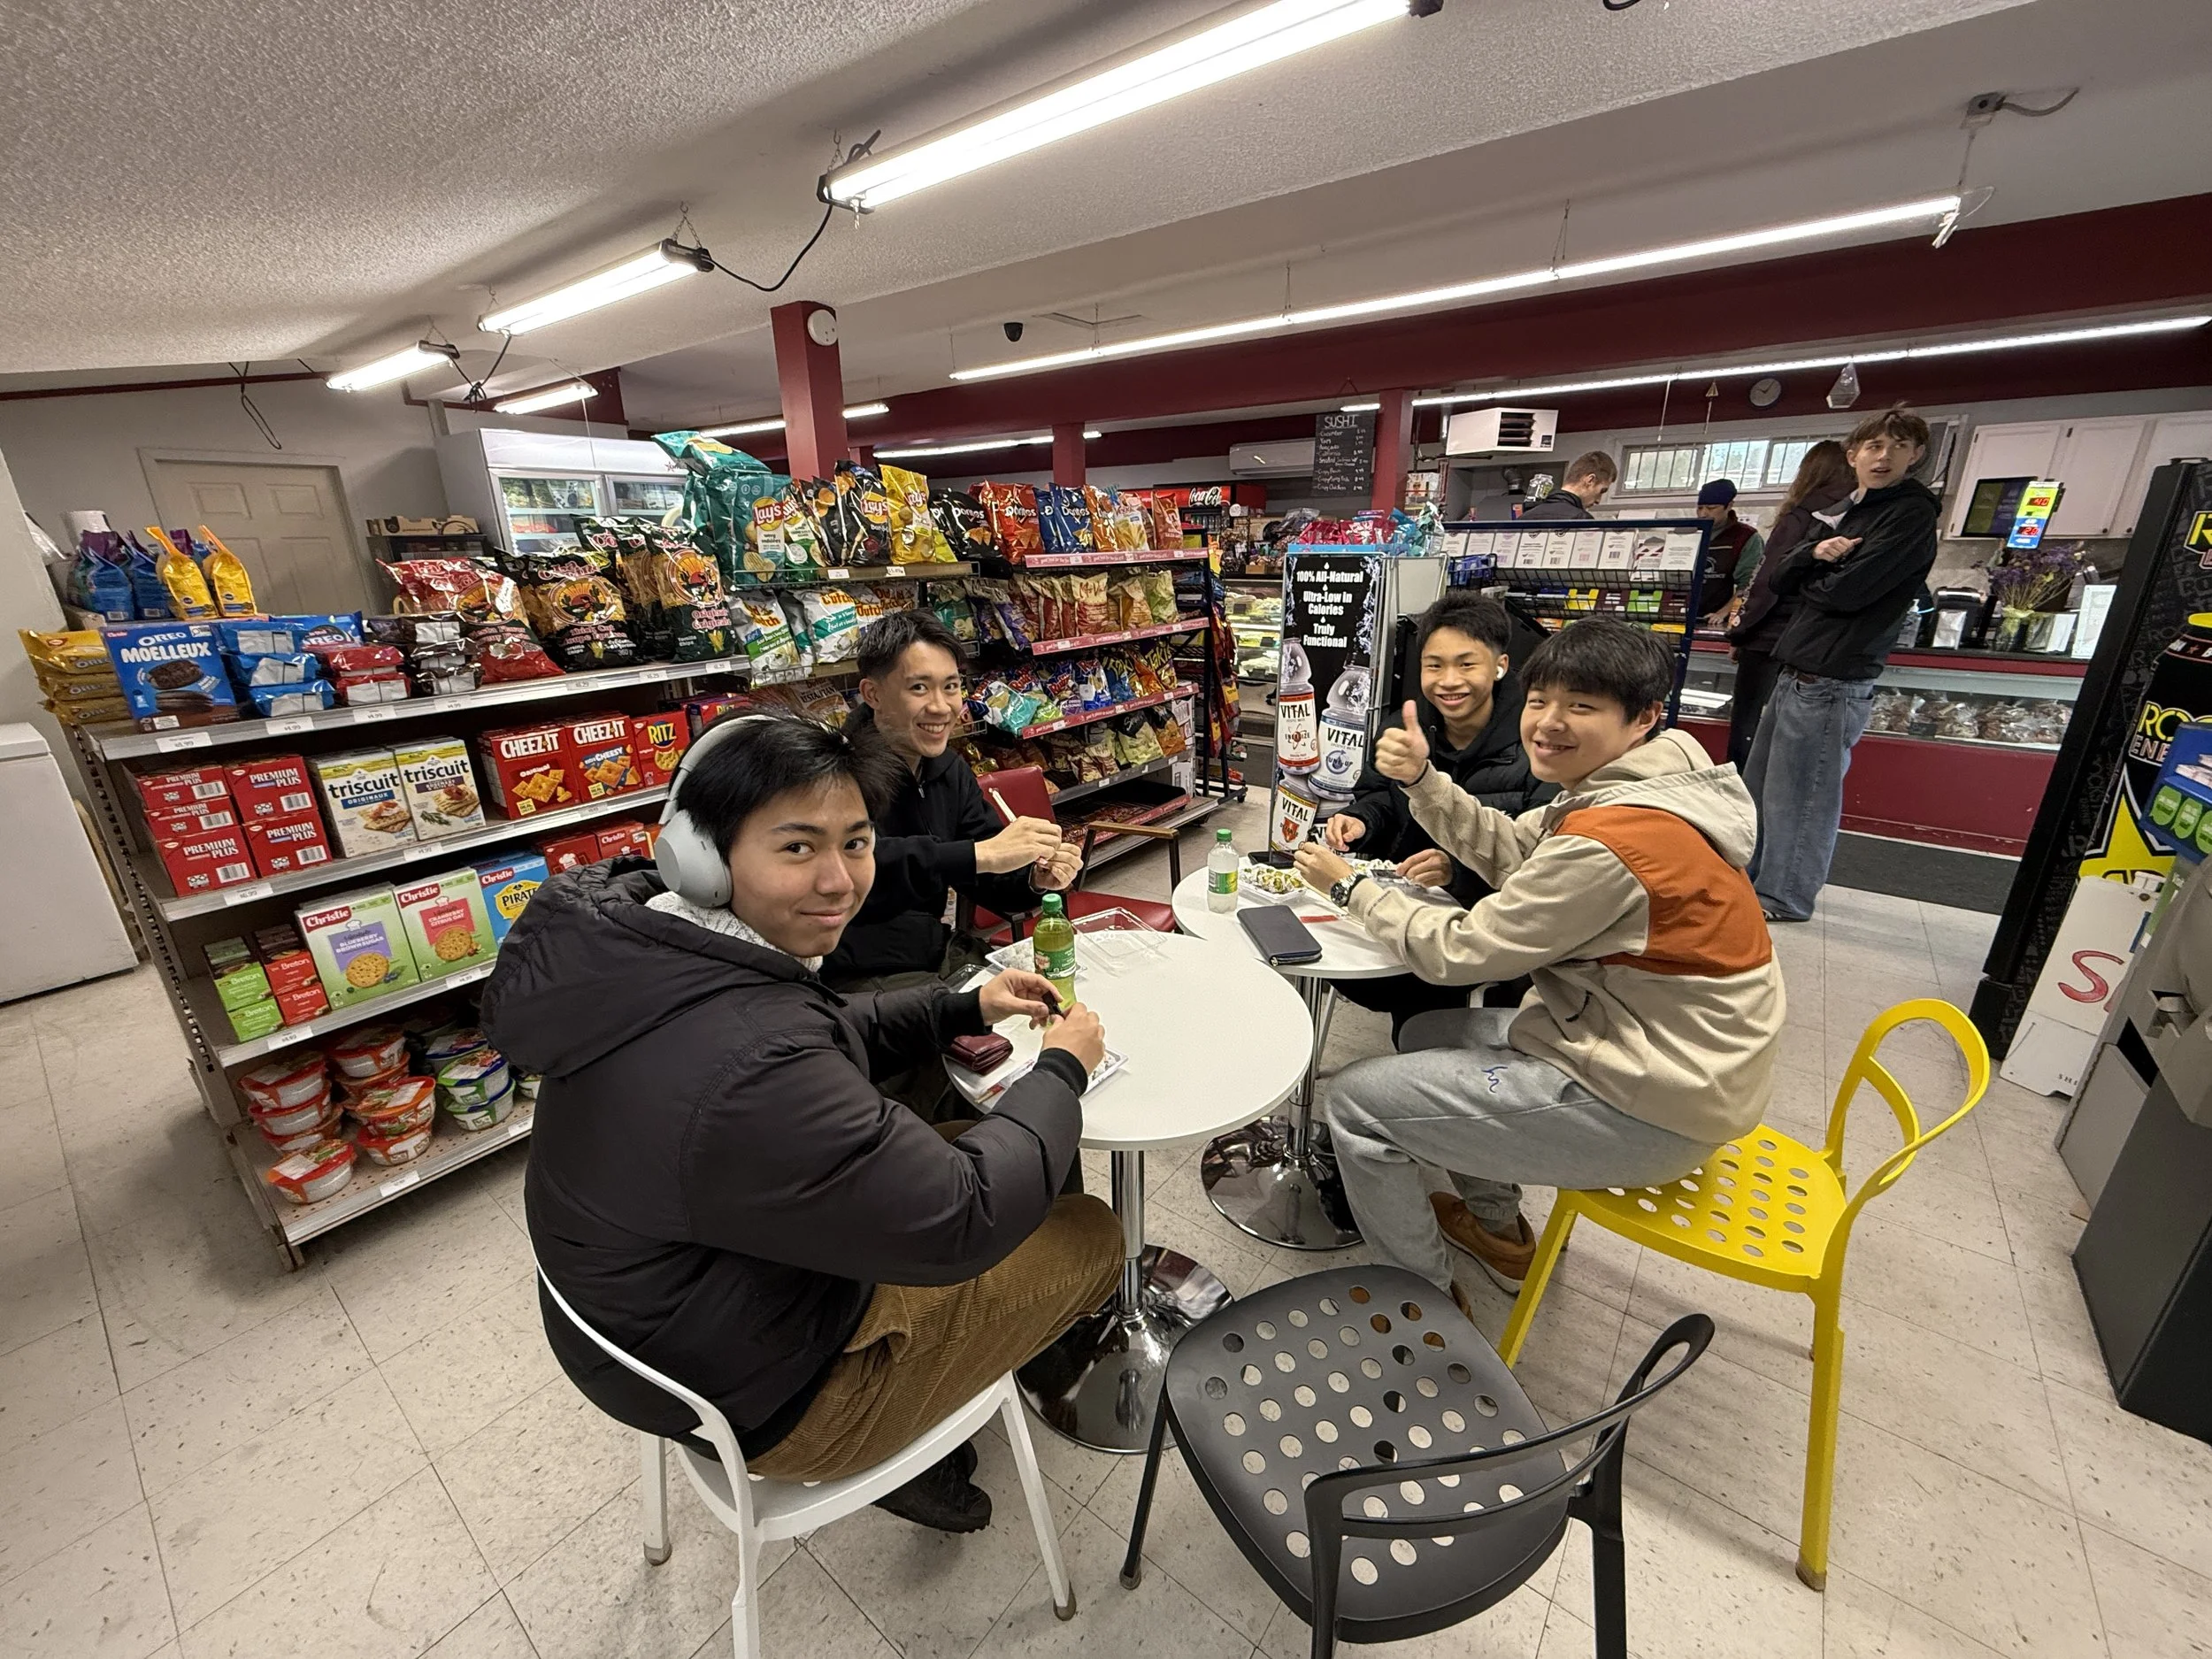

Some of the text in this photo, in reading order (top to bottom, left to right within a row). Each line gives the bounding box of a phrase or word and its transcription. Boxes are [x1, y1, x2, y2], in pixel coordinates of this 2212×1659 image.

[1324, 415, 1358, 429] SUSHI
[754, 502, 782, 525] Lay's
[952, 506, 985, 519] Doritos
[1004, 505, 1037, 518] Doritos
[1062, 506, 1090, 518] Doritos
[1296, 570, 1363, 583] 100% All-Natural
[1302, 590, 1352, 603] Ultra-Low in
[1308, 603, 1344, 616] Calories
[1313, 623, 1335, 636] Truly
[138, 631, 187, 647] OREO
[1303, 634, 1348, 648] Functional
[120, 641, 213, 664] MOELLEUX
[1280, 703, 1310, 718] VITAL
[647, 722, 678, 745] RITZ
[1327, 727, 1363, 748] VITAL
[595, 746, 624, 761] CHEESY
[2131, 734, 2170, 762] ENE
[165, 772, 200, 784] PREMIUM
[250, 767, 299, 784] PREMIUM
[403, 759, 471, 784] triscuit
[183, 777, 203, 786] PLUS
[275, 774, 302, 788] PLUS
[328, 772, 400, 799] triscuit
[348, 793, 388, 804] ORIGINAUX
[173, 803, 208, 814] PREMIUM
[191, 807, 210, 817] PLUS
[1282, 796, 1308, 821] VITAL
[266, 821, 314, 839] PREMIUM
[292, 828, 317, 842] PLUS
[601, 831, 626, 844] Christie
[183, 837, 235, 856] PREMIUM
[211, 845, 239, 859] PLUS
[481, 869, 513, 886] Christie
[400, 885, 439, 904] Christie
[306, 909, 350, 928] Christie
[428, 909, 465, 922] CRANBERRY
[431, 917, 452, 926] CITRUS
[336, 936, 384, 953] BROWN SUGAR
[340, 933, 378, 947] BLUEBERRY
[280, 958, 310, 971] Breton
[230, 972, 262, 986] Breton
[292, 988, 321, 1002] Breton
[244, 1003, 275, 1018] Breton
